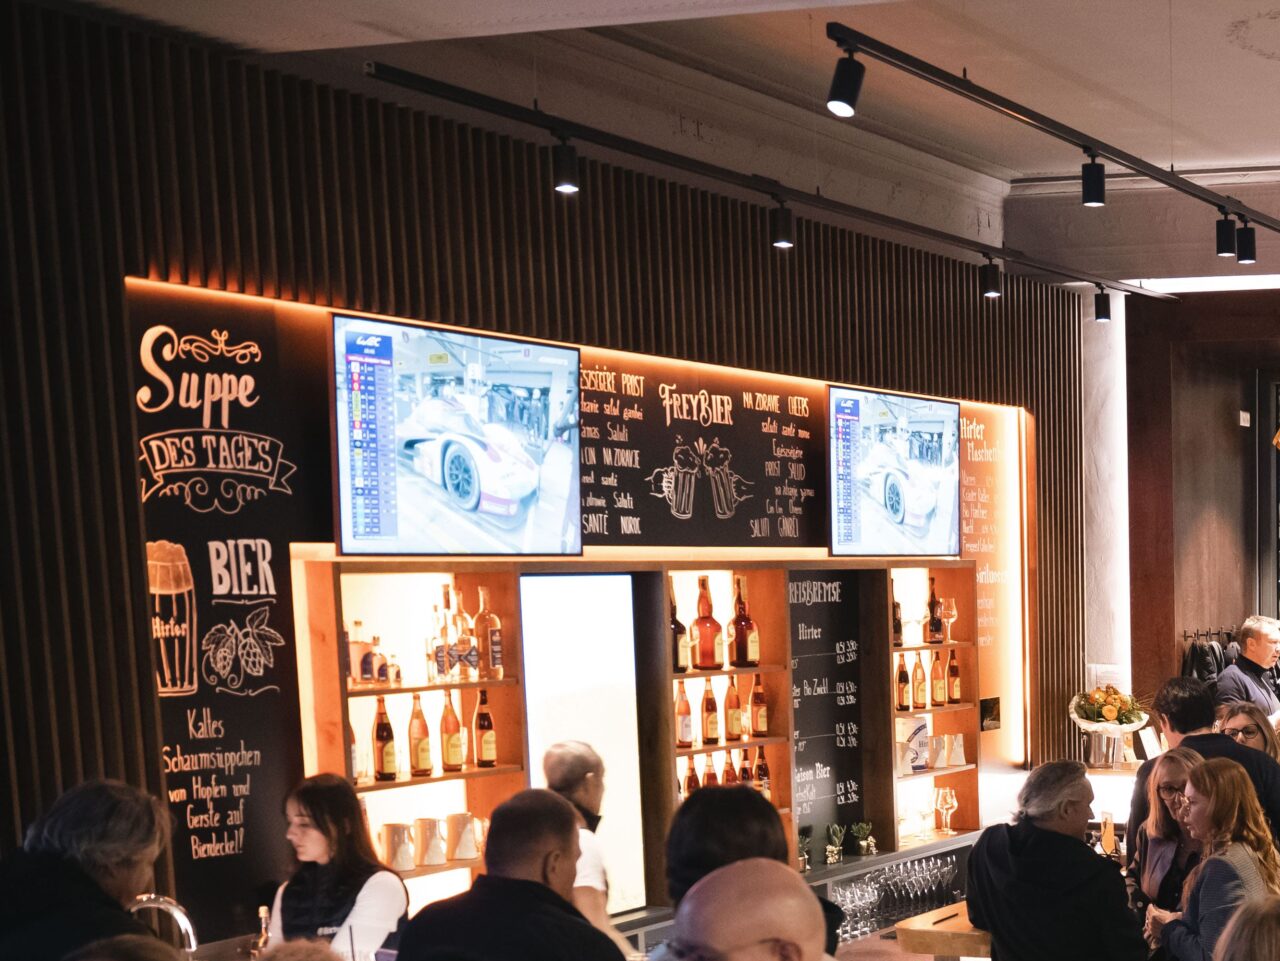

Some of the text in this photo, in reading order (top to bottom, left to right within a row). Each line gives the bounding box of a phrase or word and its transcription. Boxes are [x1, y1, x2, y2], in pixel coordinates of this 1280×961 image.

[136, 325, 260, 429] Suppe
[621, 372, 645, 398] PROST
[960, 416, 985, 441] Hirter
[149, 435, 273, 473] DES TAGES
[207, 538, 277, 595] BIER
[151, 615, 188, 640] Hirter
[798, 622, 822, 641] Hirter
[186, 706, 225, 740] Kaltes
[161, 739, 261, 776] Schaumsüppchen
[168, 773, 250, 808] von Hopfen und
[186, 798, 244, 829] Gerste auf
[190, 827, 245, 860] Bierdeckel!
